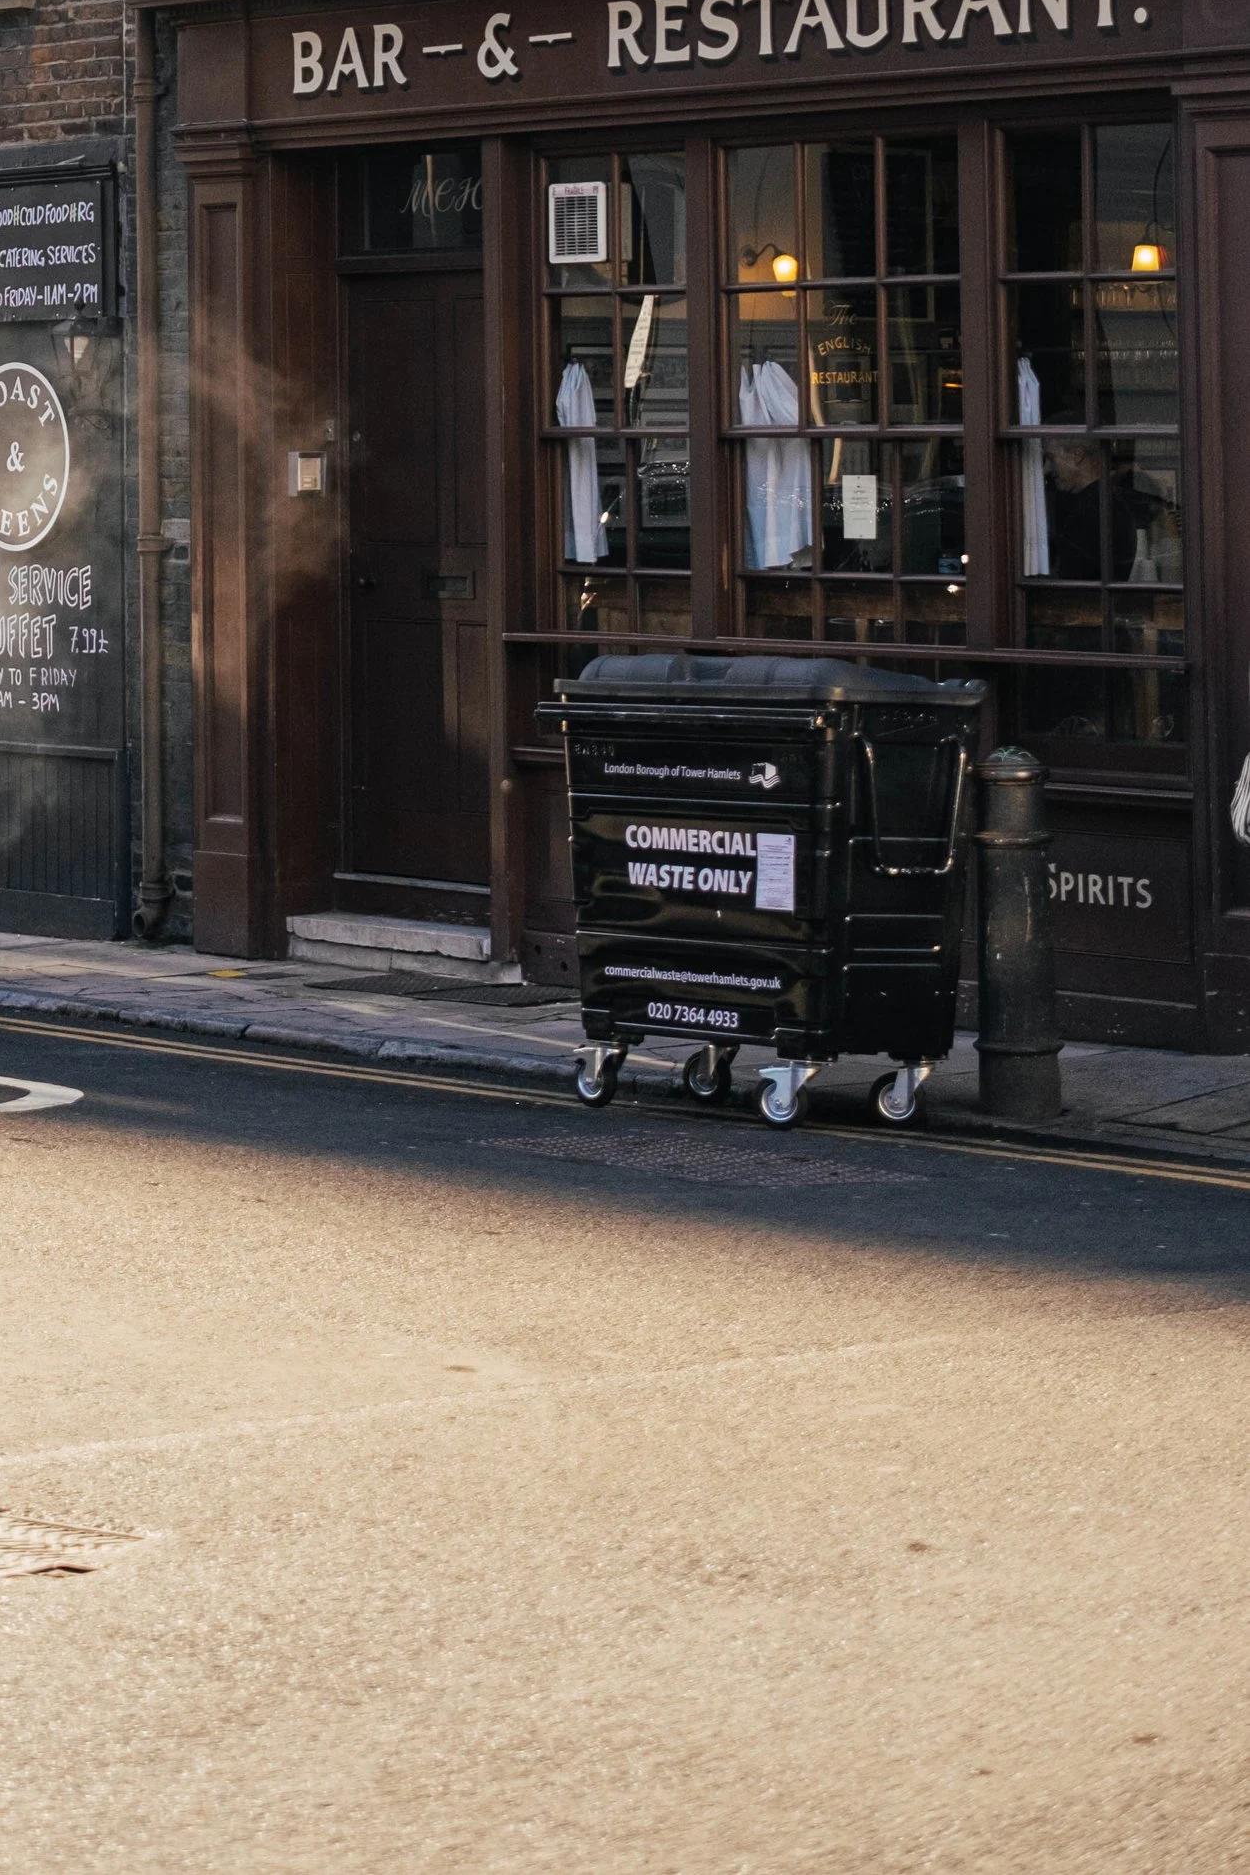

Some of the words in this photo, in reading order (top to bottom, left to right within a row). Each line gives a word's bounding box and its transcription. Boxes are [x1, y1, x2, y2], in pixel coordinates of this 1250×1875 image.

[290, 21, 408, 95] BAR
[475, 12, 518, 79] &
[47, 243, 96, 265] SERVICES
[817, 336, 871, 357] ENGLISH
[811, 370, 879, 385] RESTAURANT
[6, 441, 25, 473] &
[8, 564, 92, 611] SERVICE
[8, 667, 22, 686] TO
[29, 667, 78, 688] FRIDAY
[31, 692, 60, 713] 3PM
[604, 762, 635, 774] London
[636, 763, 669, 778] Borough
[670, 765, 680, 776] of
[681, 766, 705, 778] Tower
[707, 767, 741, 780] Hamlets
[625, 824, 757, 857] COMMERCIAL
[627, 861, 695, 890] WASTE
[698, 867, 753, 895] ONLY
[604, 965, 782, 991] commercialwaste@towerhamlets.gov.uk
[647, 1001, 671, 1019] 020
[674, 1005, 705, 1024] 7364
[707, 1008, 739, 1028] 4933
